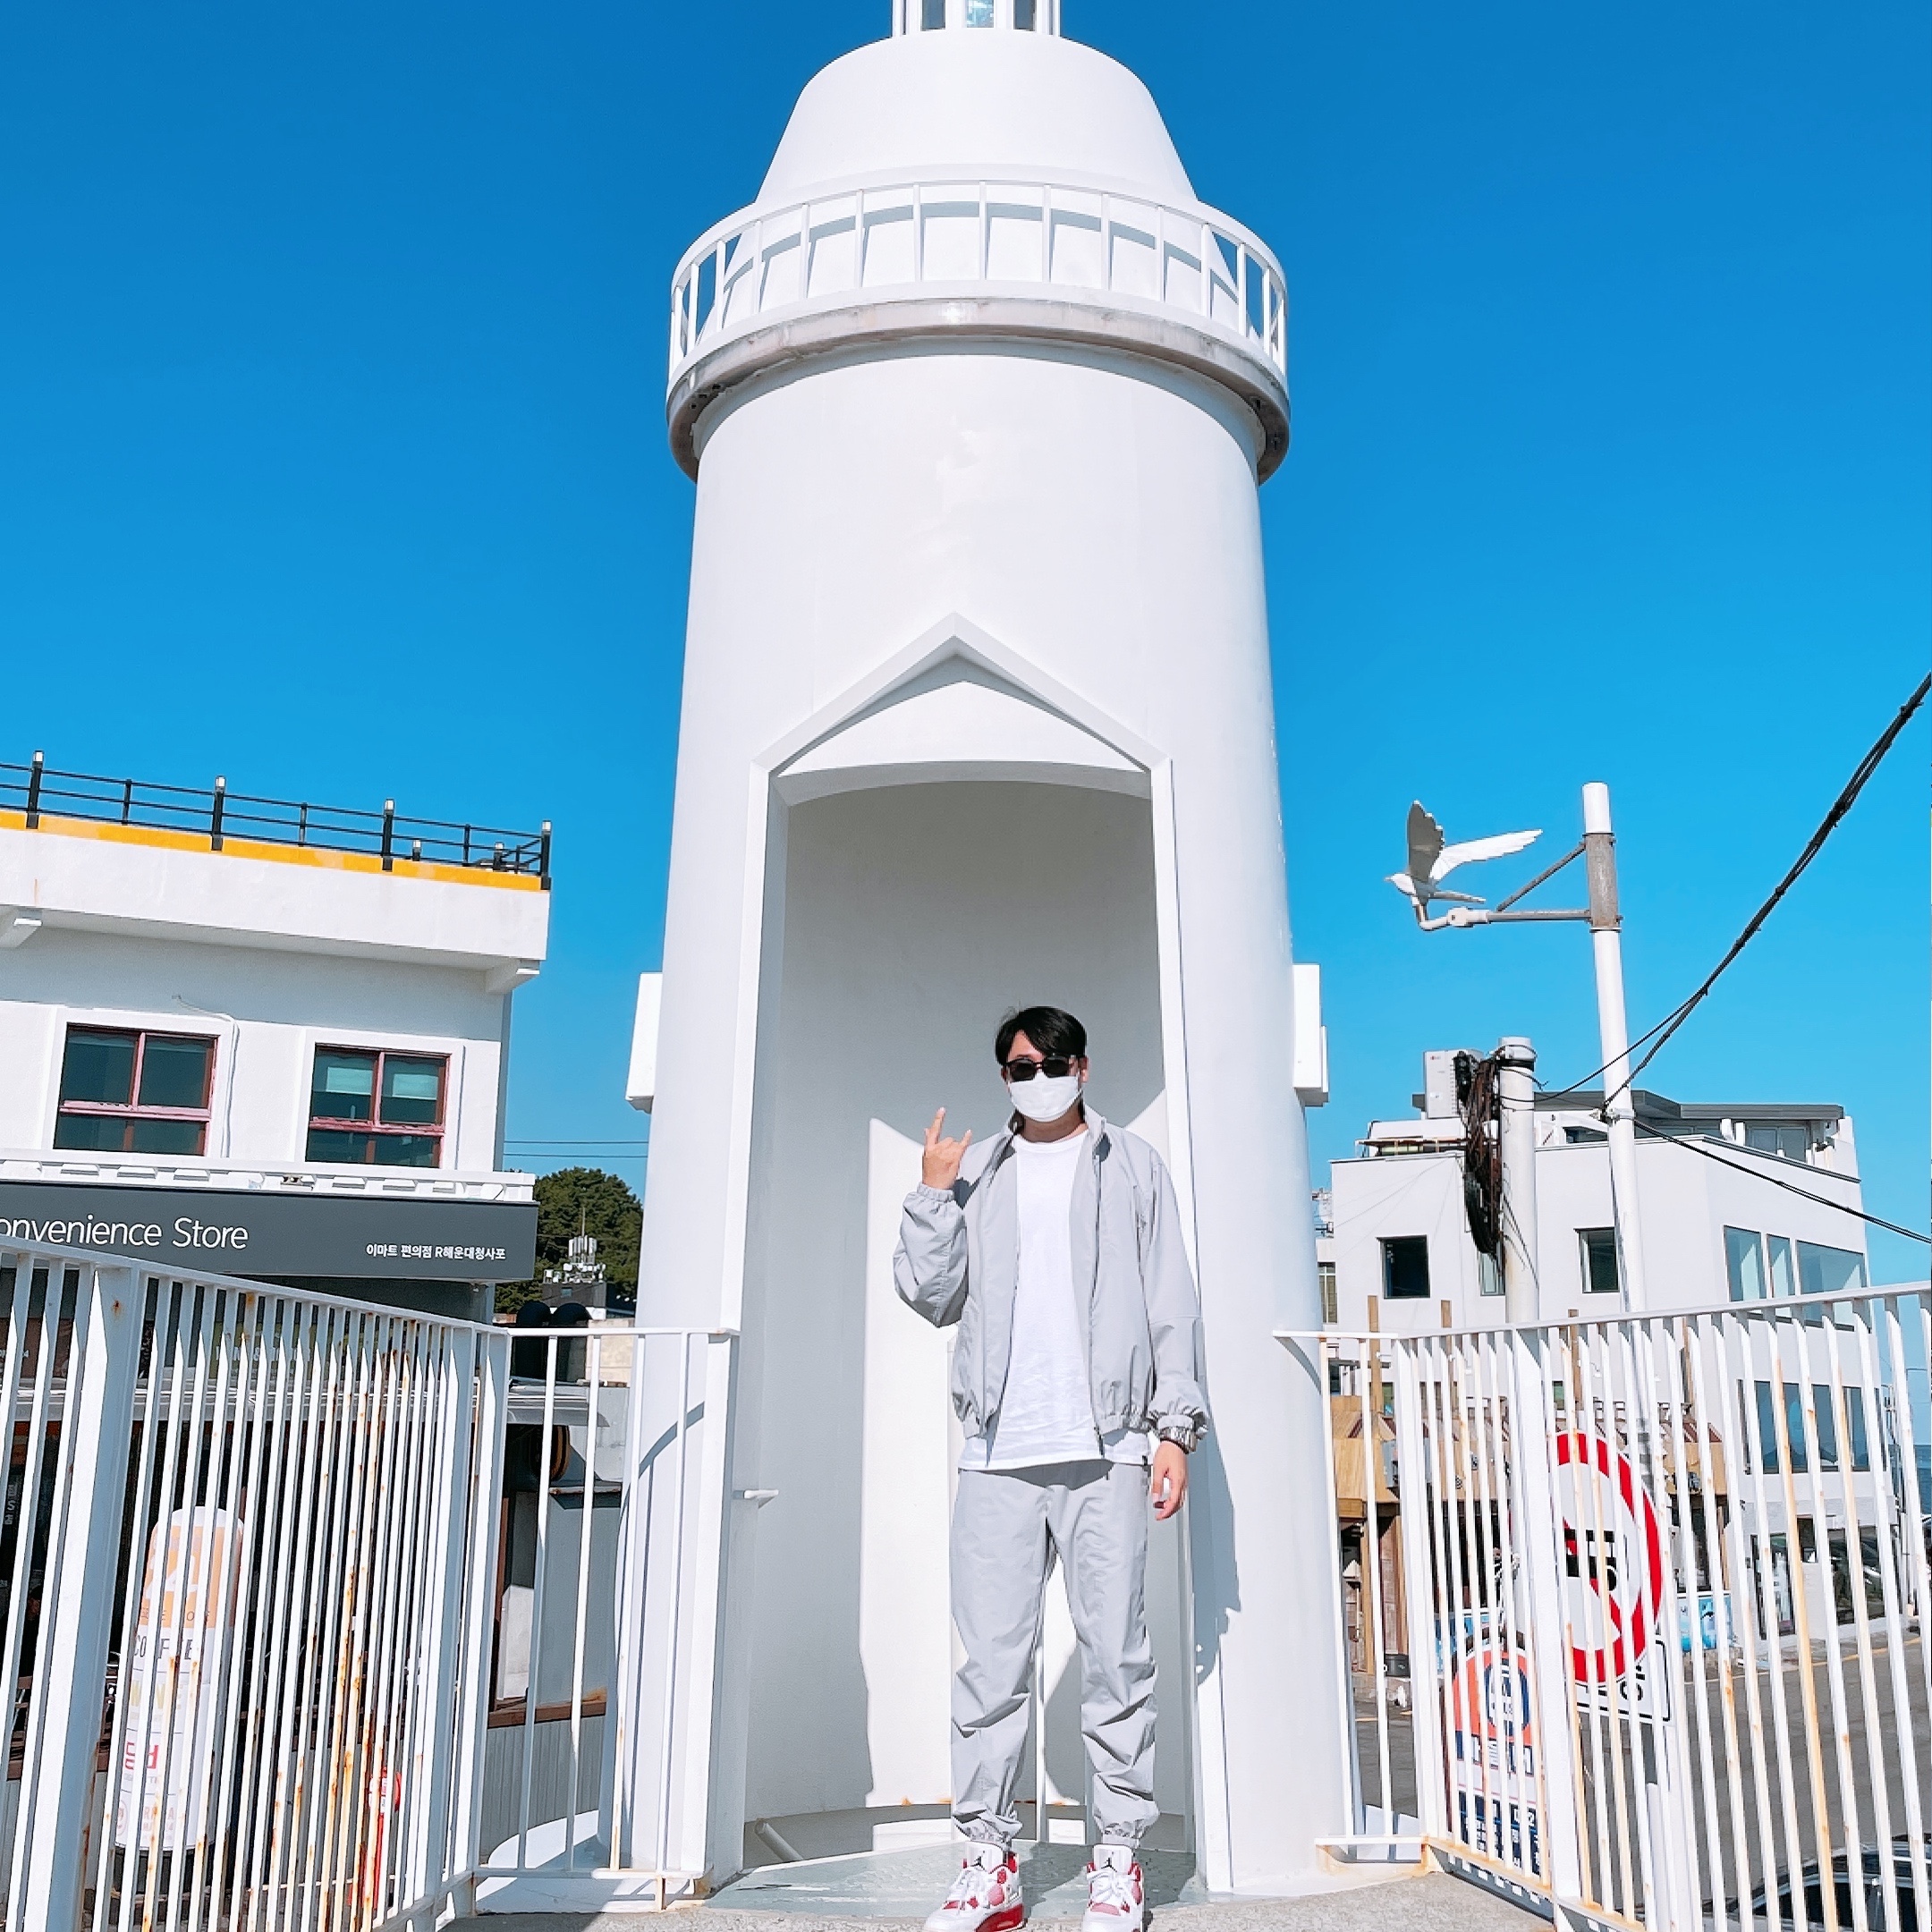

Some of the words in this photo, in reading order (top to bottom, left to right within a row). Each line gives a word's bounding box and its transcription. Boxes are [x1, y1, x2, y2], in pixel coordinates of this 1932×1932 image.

[172, 1216, 249, 1250] Store
[366, 1243, 398, 1258] 이마트
[400, 1244, 432, 1258] 편의점
[435, 1245, 506, 1260] R해운대청사포
